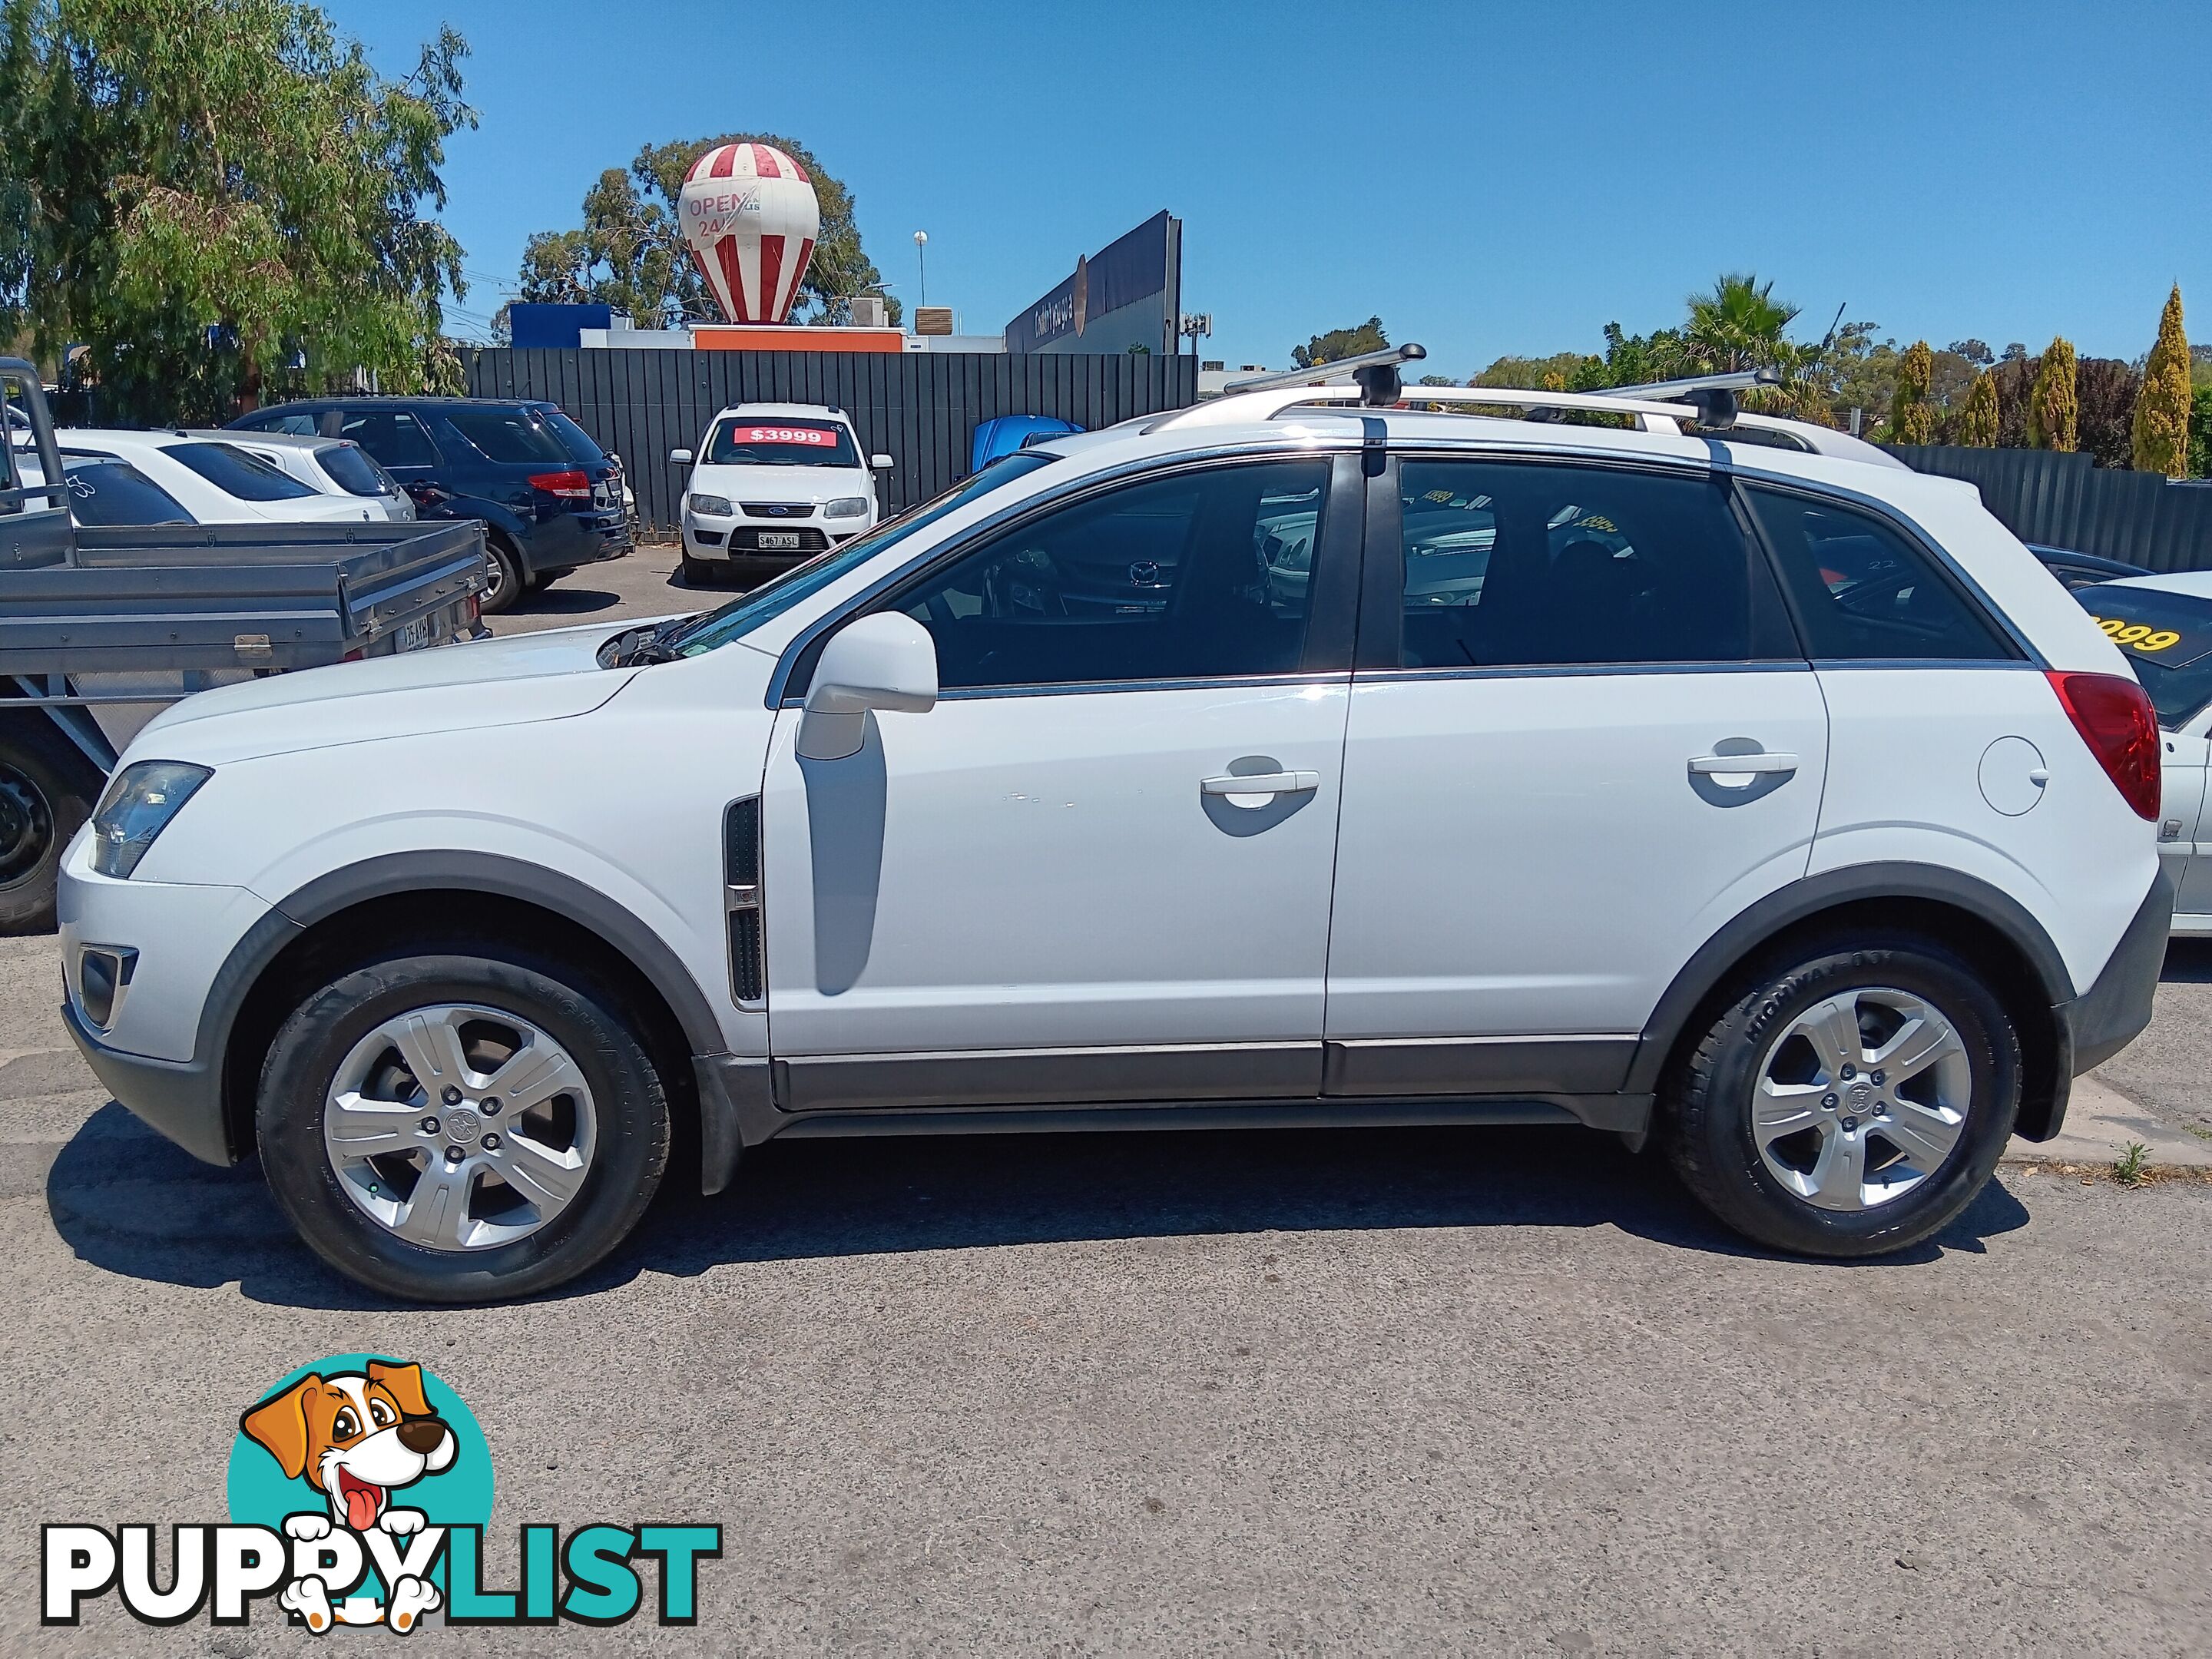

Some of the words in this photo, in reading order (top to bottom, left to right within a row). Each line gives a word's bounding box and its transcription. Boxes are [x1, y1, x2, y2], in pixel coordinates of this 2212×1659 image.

[690, 192, 747, 217] OPEN
[750, 429, 822, 443] $3999
[760, 536, 779, 545] S467
[782, 536, 798, 545] ASL
